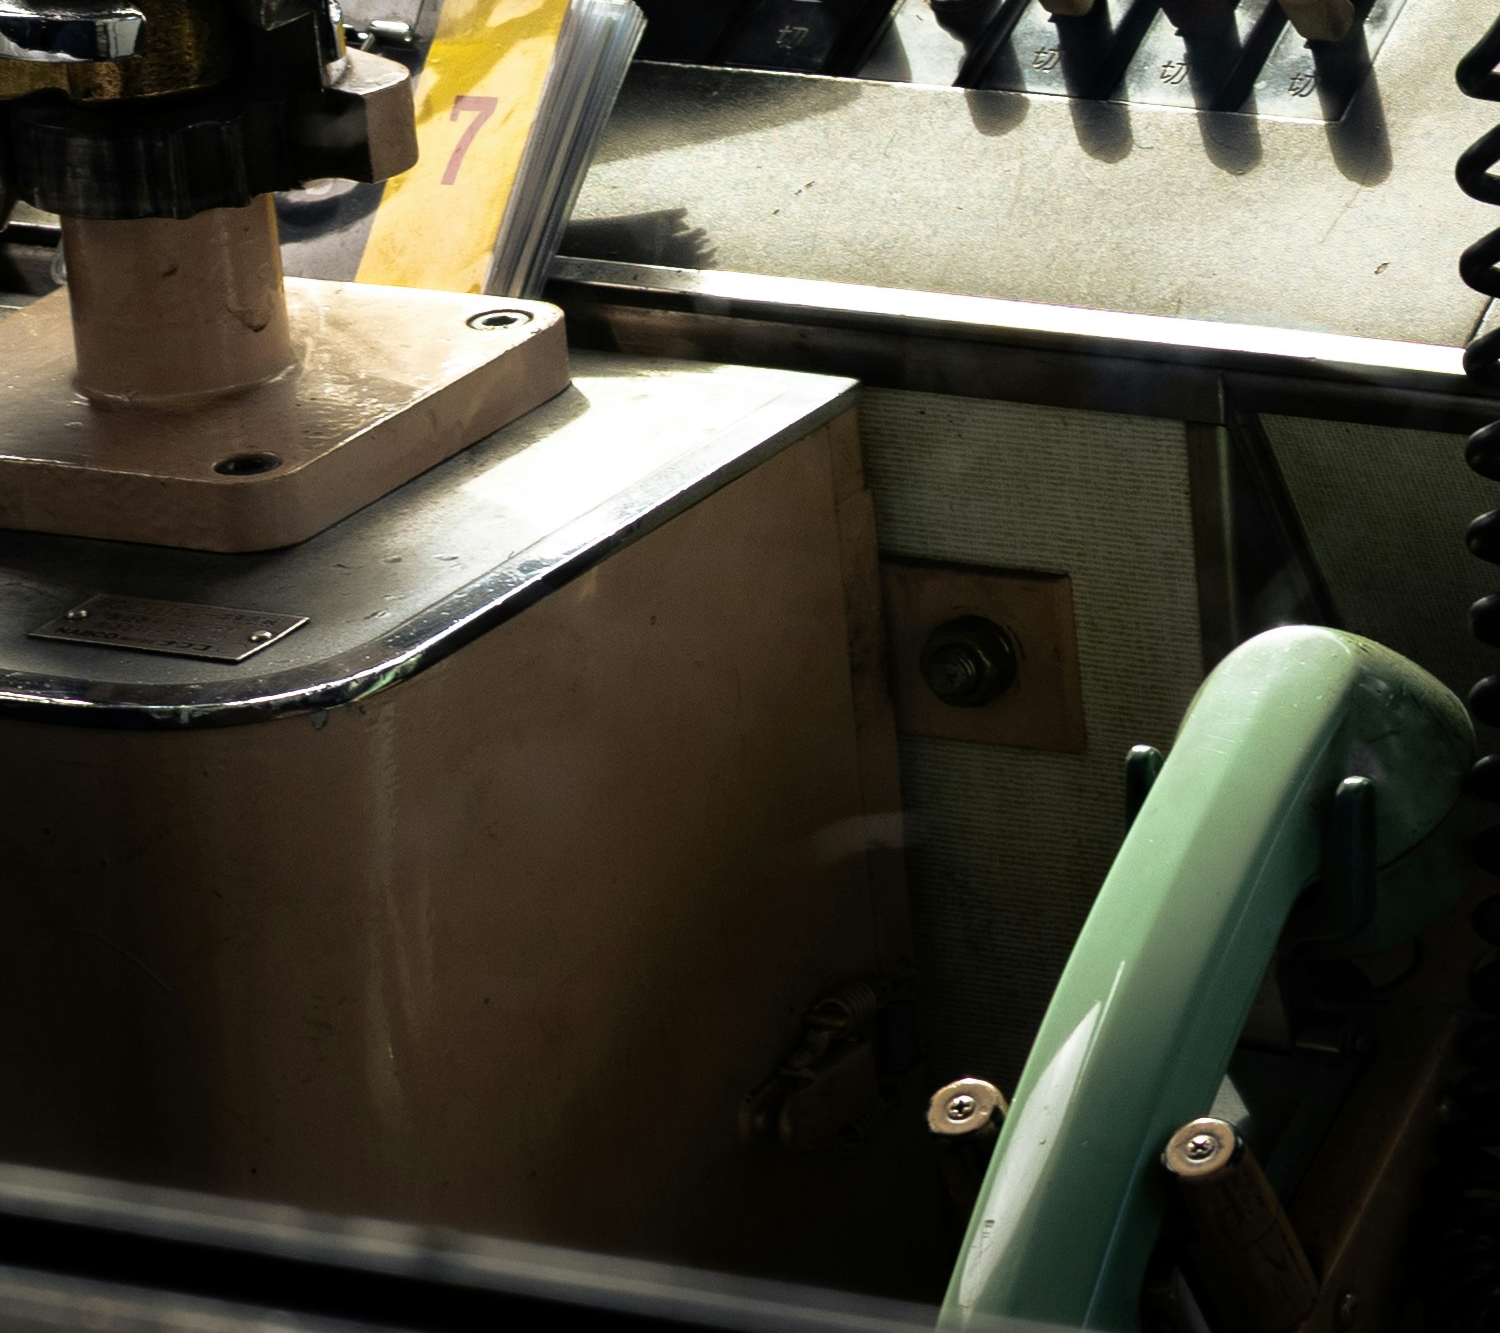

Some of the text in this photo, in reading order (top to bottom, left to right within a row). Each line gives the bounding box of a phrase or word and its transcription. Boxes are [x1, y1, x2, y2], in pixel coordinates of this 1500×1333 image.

[776, 24, 809, 50] 切
[1032, 46, 1061, 73] 切
[1160, 59, 1189, 86] 切
[1288, 72, 1318, 99] 切
[440, 95, 499, 187] 7
